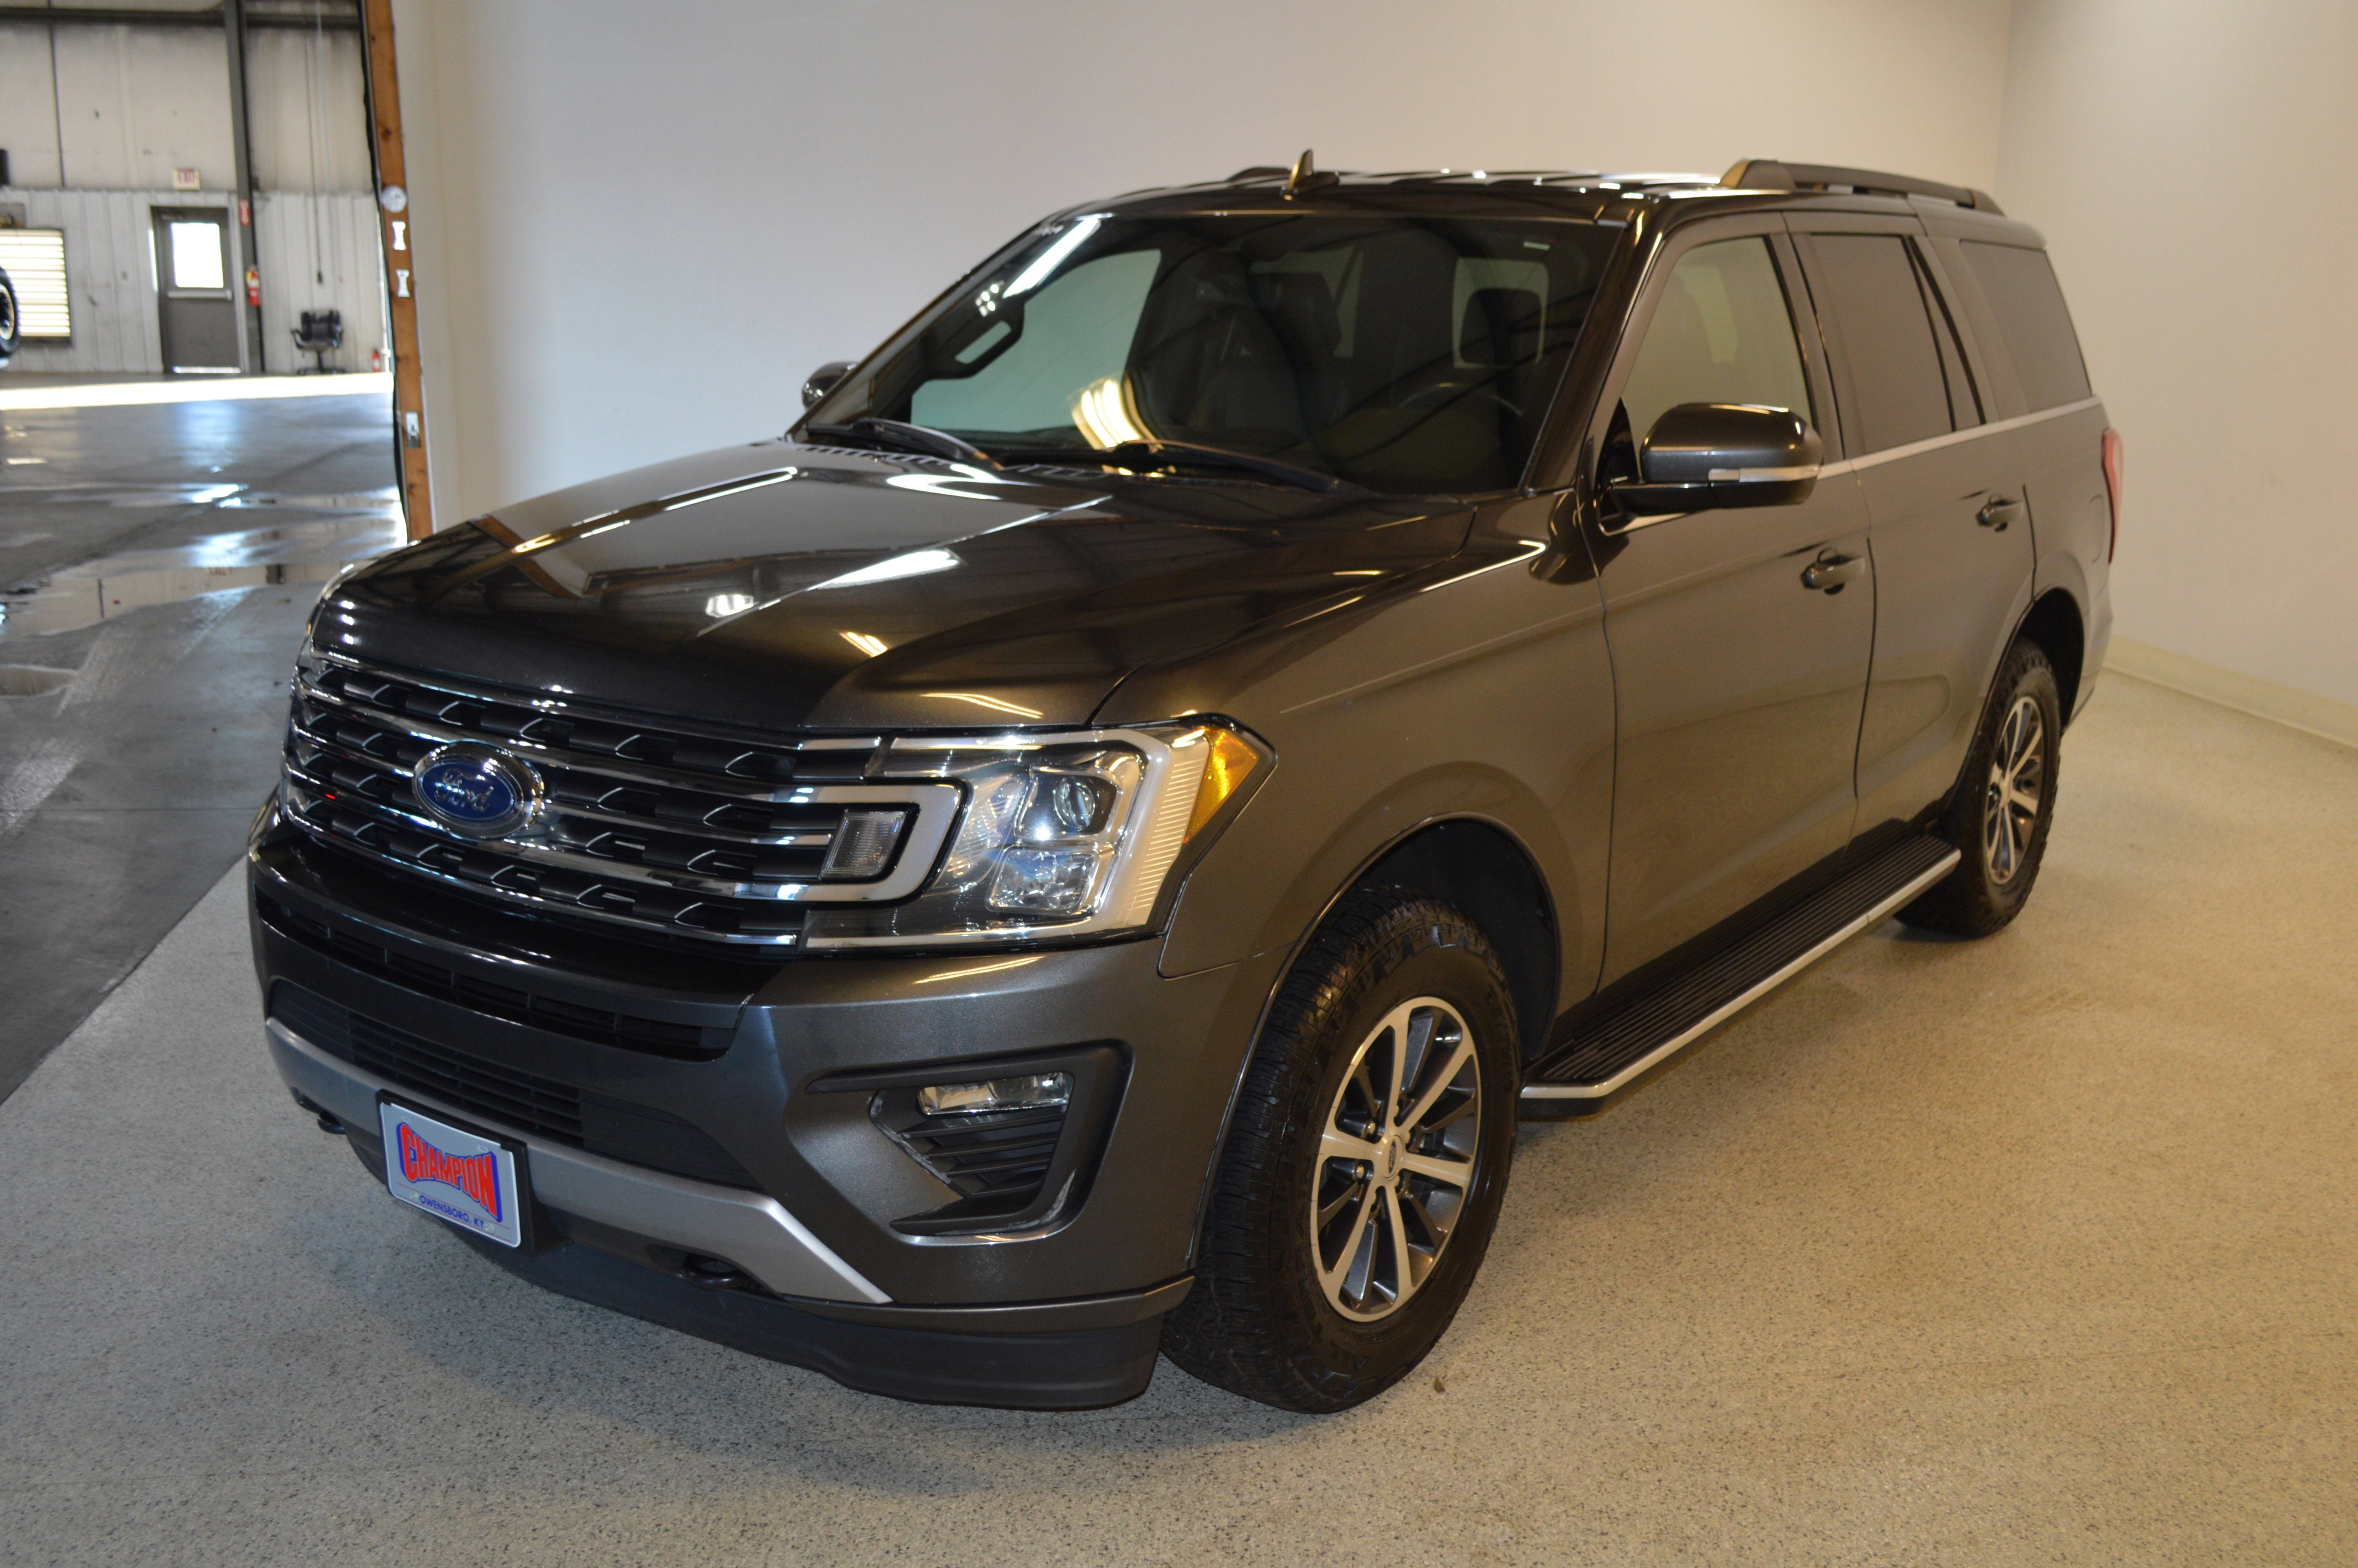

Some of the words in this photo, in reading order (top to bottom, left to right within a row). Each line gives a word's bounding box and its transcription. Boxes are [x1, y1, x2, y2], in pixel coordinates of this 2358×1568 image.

[435, 768, 494, 812] Ford
[397, 1122, 502, 1222] CHAMPION
[420, 1195, 471, 1223] OWENSBORO,
[474, 1217, 485, 1228] KY
